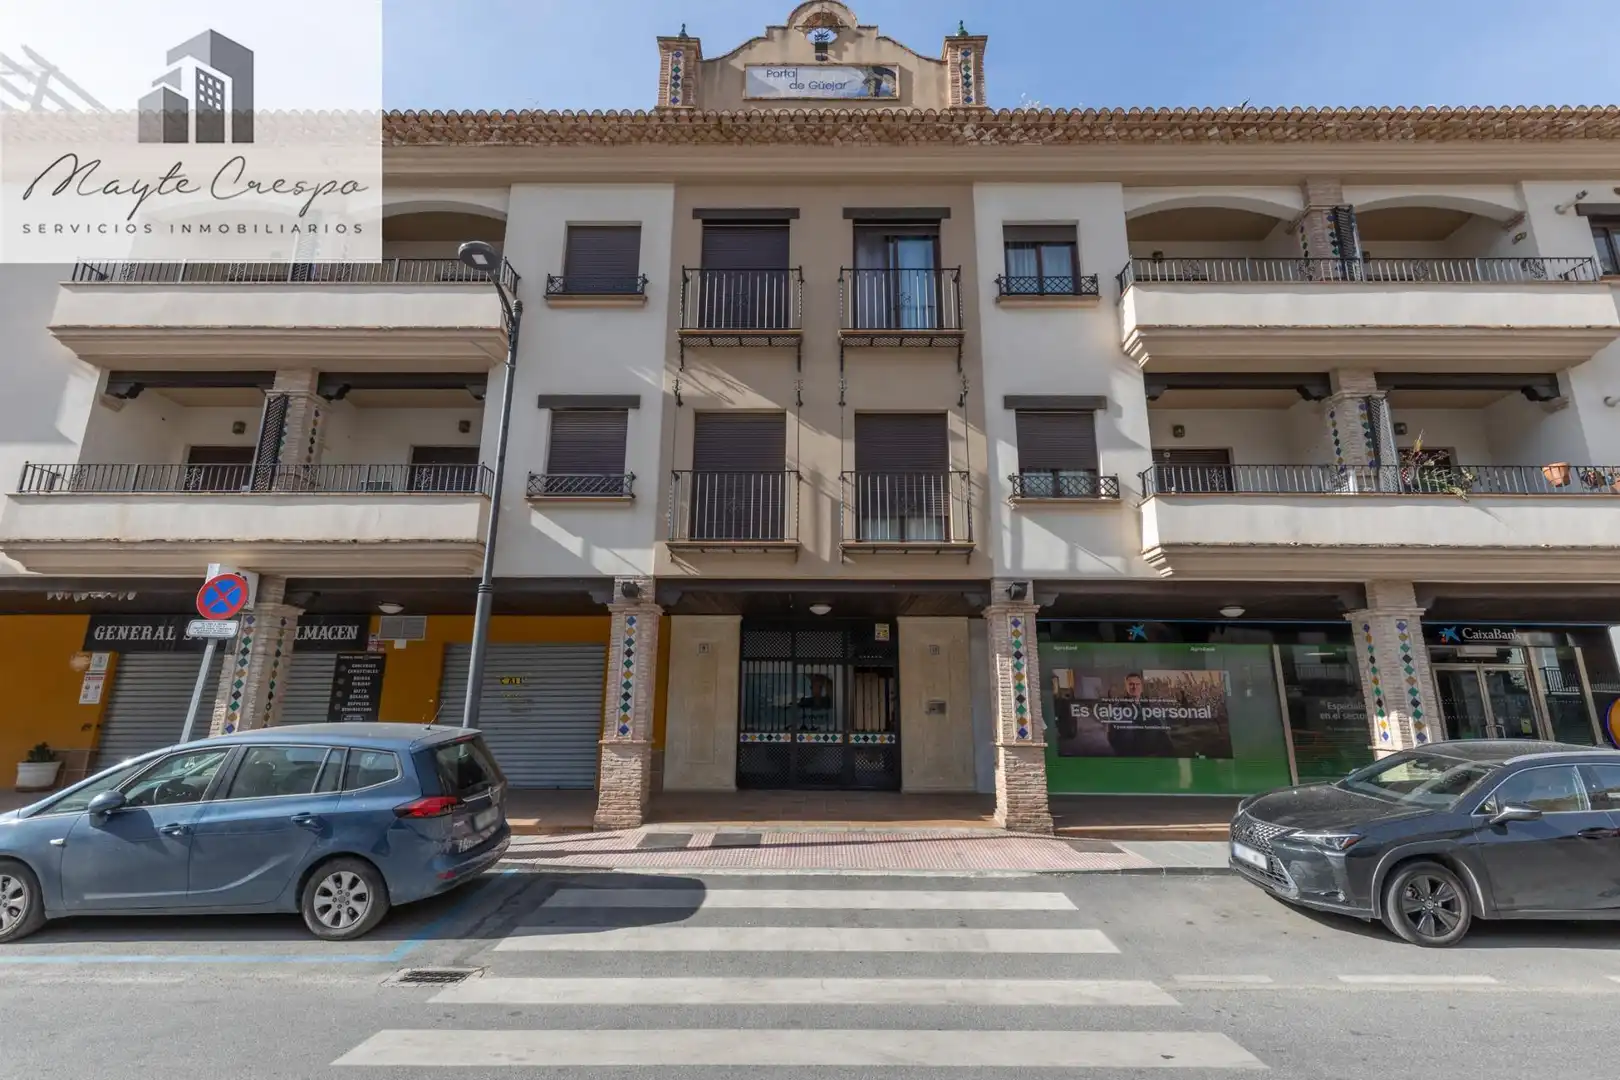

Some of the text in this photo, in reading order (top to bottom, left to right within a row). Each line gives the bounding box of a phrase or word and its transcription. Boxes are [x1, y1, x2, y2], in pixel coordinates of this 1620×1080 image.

[766, 68, 798, 79] Portal
[789, 76, 848, 91] de Güejar
[94, 625, 176, 640] GENERAL
[294, 625, 359, 640] LMACEN
[1462, 627, 1521, 640] CaixaBank
[1070, 703, 1211, 720] Es (algo) personal
